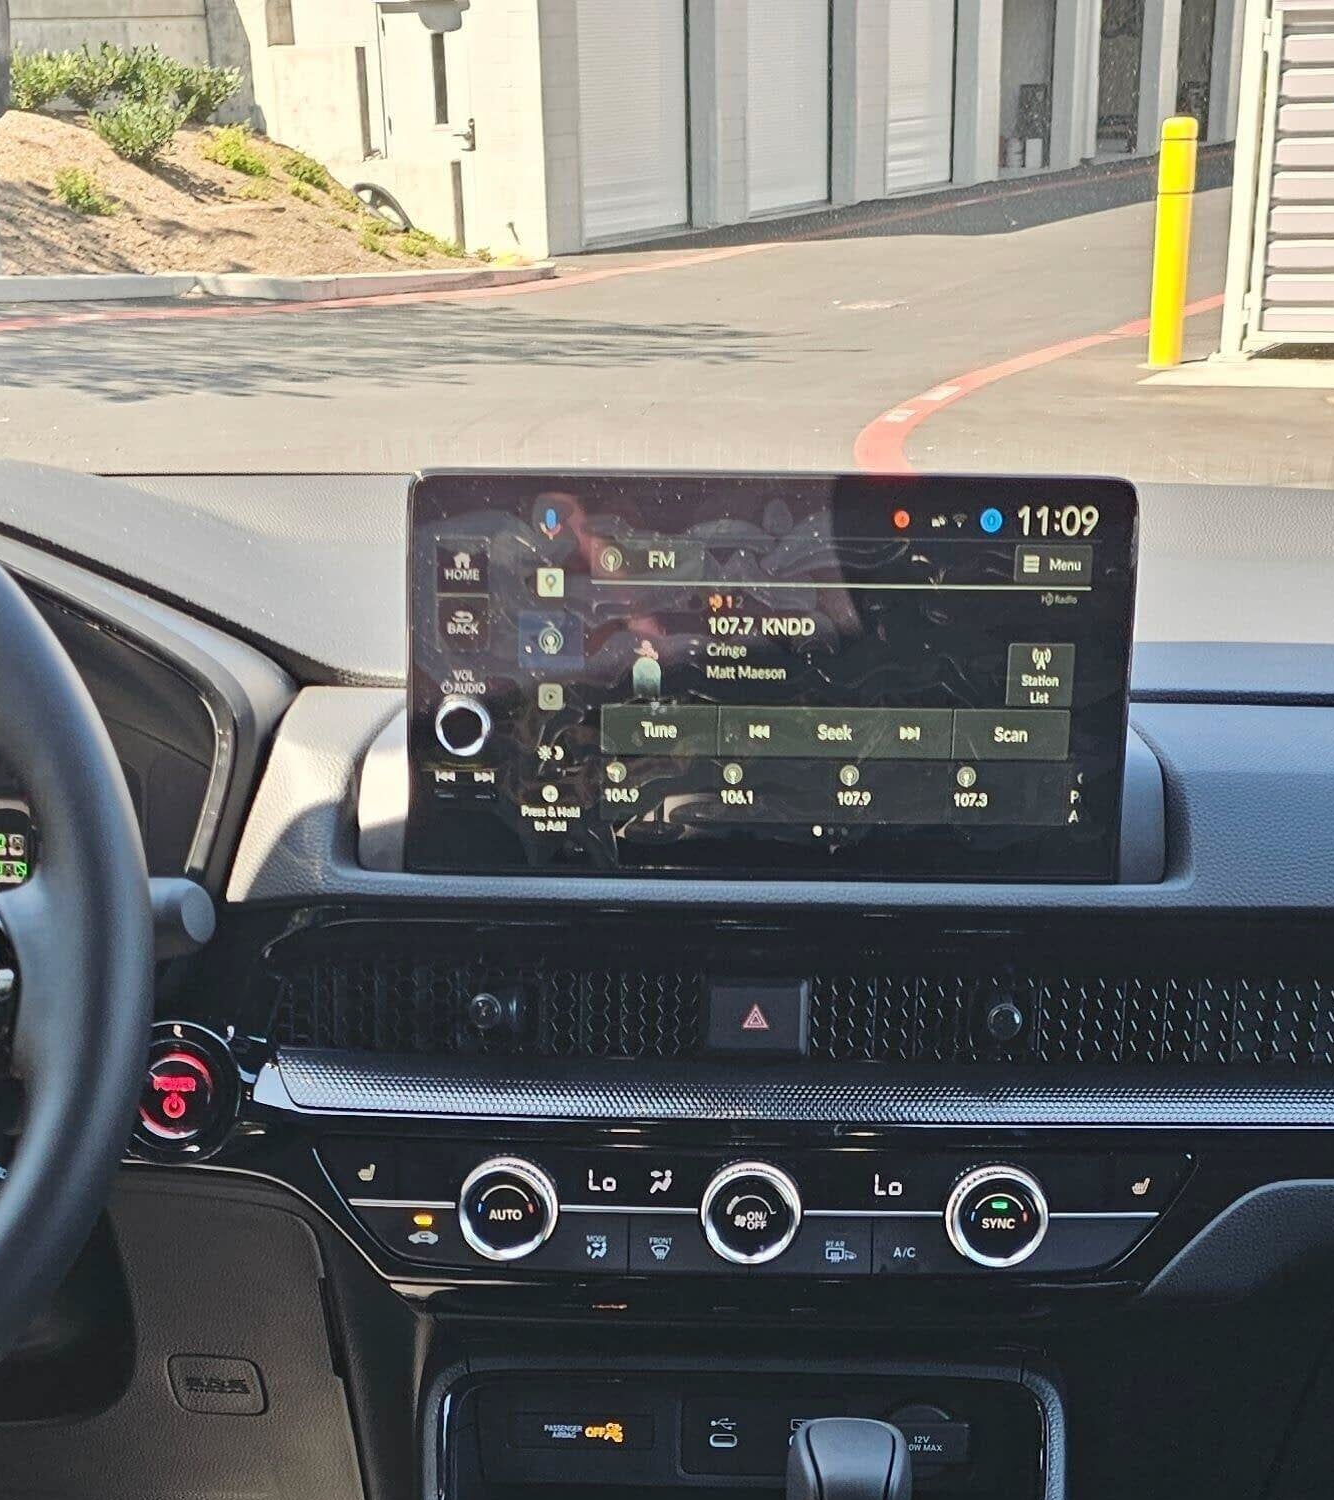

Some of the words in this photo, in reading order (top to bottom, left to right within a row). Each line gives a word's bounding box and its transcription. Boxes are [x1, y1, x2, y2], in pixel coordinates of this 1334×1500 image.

[1017, 505, 1100, 537] 11:09
[648, 551, 675, 569] FM
[1049, 558, 1082, 572] Menu
[444, 568, 480, 581] HOME
[446, 623, 479, 635] BACK
[708, 617, 754, 636] 107.7
[761, 617, 815, 637] KNDD
[706, 642, 747, 659] Cringe
[452, 669, 475, 681] VOL
[706, 665, 735, 680] Matt
[738, 665, 786, 681] Maeson
[1021, 674, 1060, 687] Station
[455, 682, 486, 694] AUDIO
[1029, 691, 1050, 704] List
[641, 721, 678, 739] Tune
[817, 723, 853, 742] Seek
[993, 726, 1029, 743] Scan
[604, 788, 640, 803] 104.9
[837, 791, 872, 806] 107.9
[588, 1169, 616, 1192] Lo
[874, 1173, 903, 1195] Lo
[489, 1209, 522, 1220] AUTO
[747, 1220, 767, 1230] OFF
[981, 1217, 1015, 1229] SYNC
[649, 1236, 672, 1245] FRONT
[893, 1246, 915, 1258] A/C
[544, 1424, 583, 1433] PASSENGER
